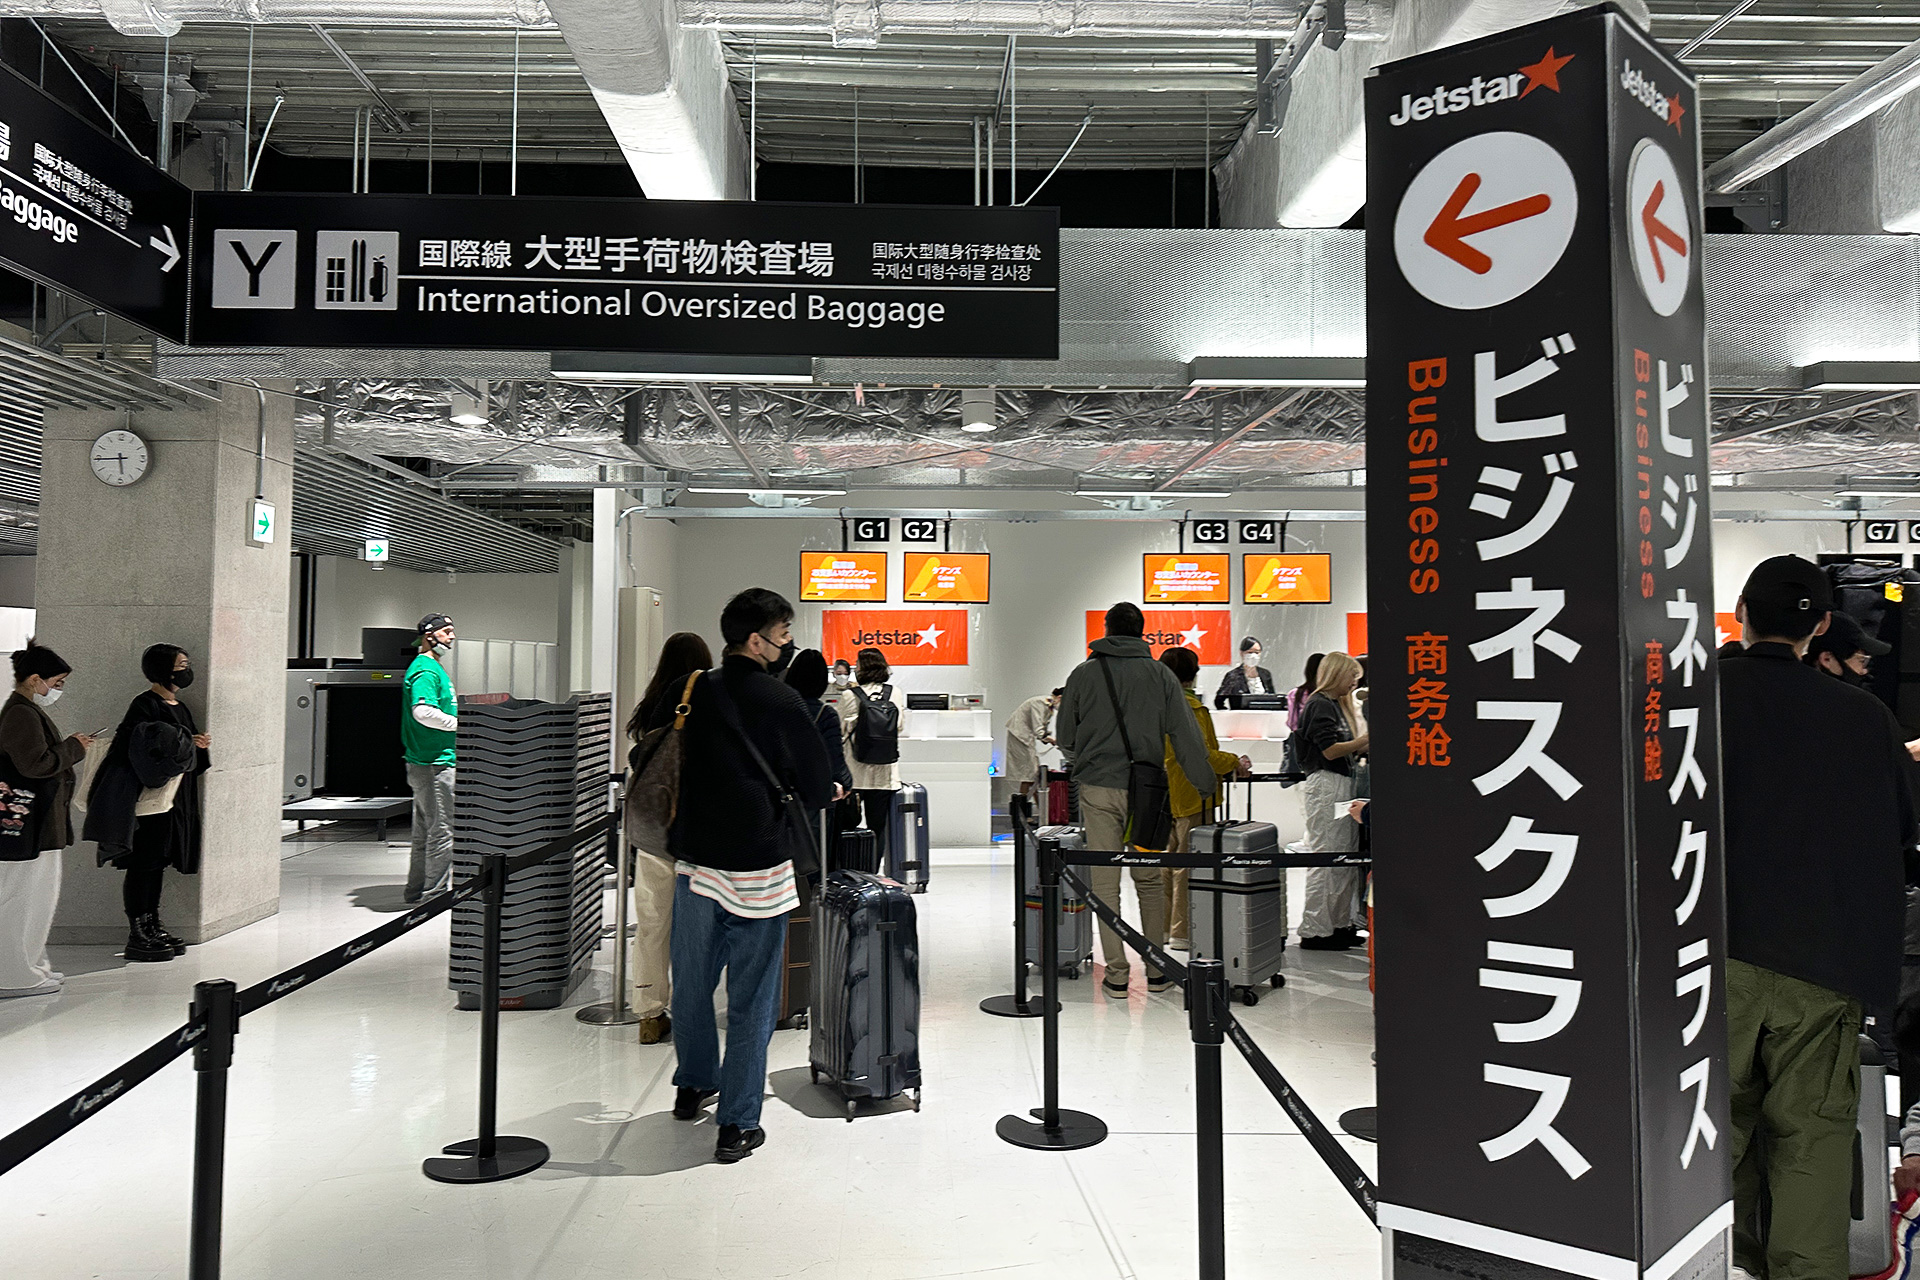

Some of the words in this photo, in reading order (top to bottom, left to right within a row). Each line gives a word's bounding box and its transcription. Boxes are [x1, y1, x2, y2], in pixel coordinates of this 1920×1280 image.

[1389, 72, 1527, 127] Jetstar
[1621, 59, 1669, 121] Jetstar
[0, 178, 78, 243] aggage
[228, 240, 283, 297] Y
[418, 239, 512, 269] 国際線
[524, 234, 835, 278] 大型手荷物検査場
[871, 263, 914, 280] 국제선
[916, 264, 987, 281] 대형수하물
[990, 265, 1032, 282] 검사장
[872, 242, 1042, 262] 国际大型随身行李检查处
[418, 286, 632, 316] International
[641, 289, 798, 321] Oversized
[807, 295, 945, 329] Baggage
[1408, 356, 1449, 595] Business
[1634, 348, 1655, 599] Business
[858, 521, 886, 539] G1
[904, 521, 935, 539] G2
[1195, 523, 1226, 541] G3
[1242, 523, 1274, 541] G4
[1866, 522, 1896, 541] G7
[851, 629, 921, 646] Jetstar
[1406, 631, 1452, 767] 商务舱
[1644, 638, 1664, 782] 商务舱
[1468, 333, 1593, 1181] ビジネスクラス
[1658, 360, 1718, 1170] ビジネスクラス
